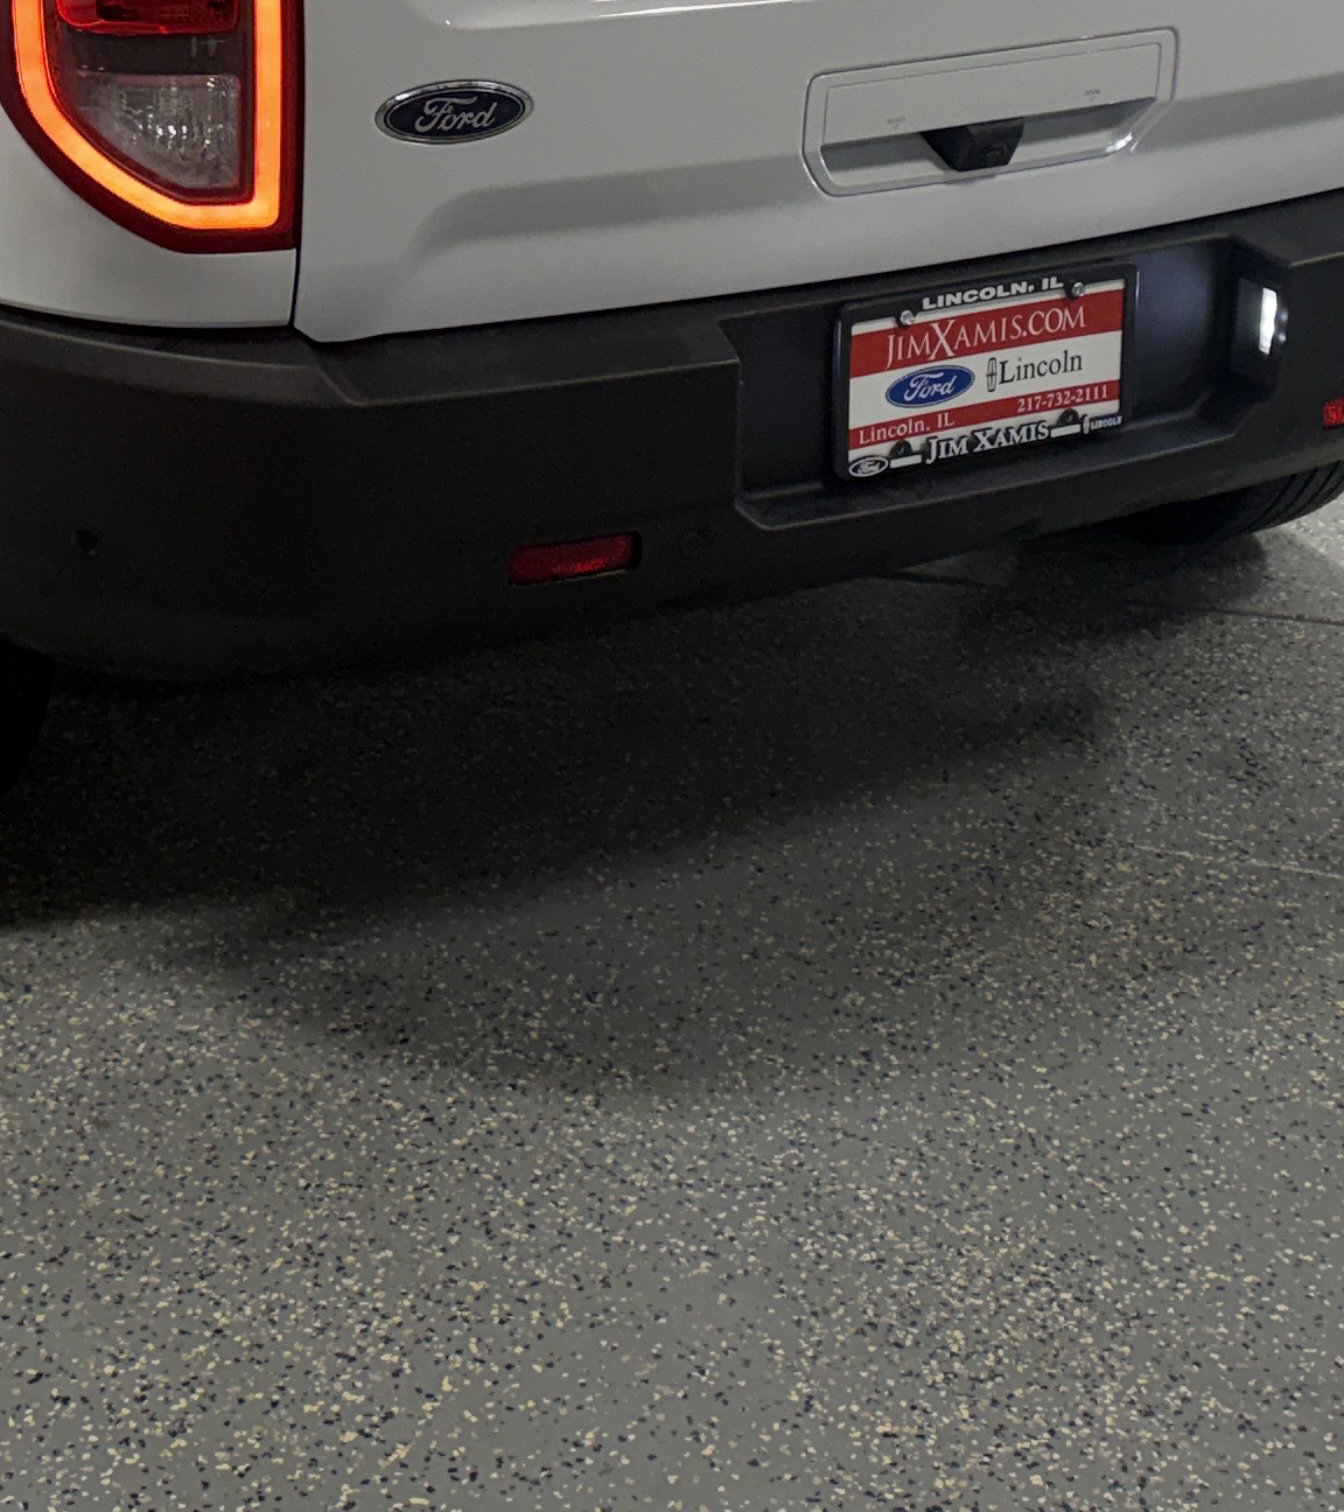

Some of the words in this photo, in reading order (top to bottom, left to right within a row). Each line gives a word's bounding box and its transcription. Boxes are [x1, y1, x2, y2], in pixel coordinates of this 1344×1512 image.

[414, 96, 498, 133] Ford
[922, 281, 1035, 310] LINCOLN,
[1041, 276, 1064, 289] IL
[887, 307, 1086, 369] JIMXAMIS.COM
[998, 350, 1083, 384] Lincoln
[903, 372, 956, 401] Ford
[1017, 384, 1108, 413] 217-732-2111
[937, 412, 955, 428] IL
[925, 437, 968, 465] JIM
[972, 422, 1049, 453] XAMIS
